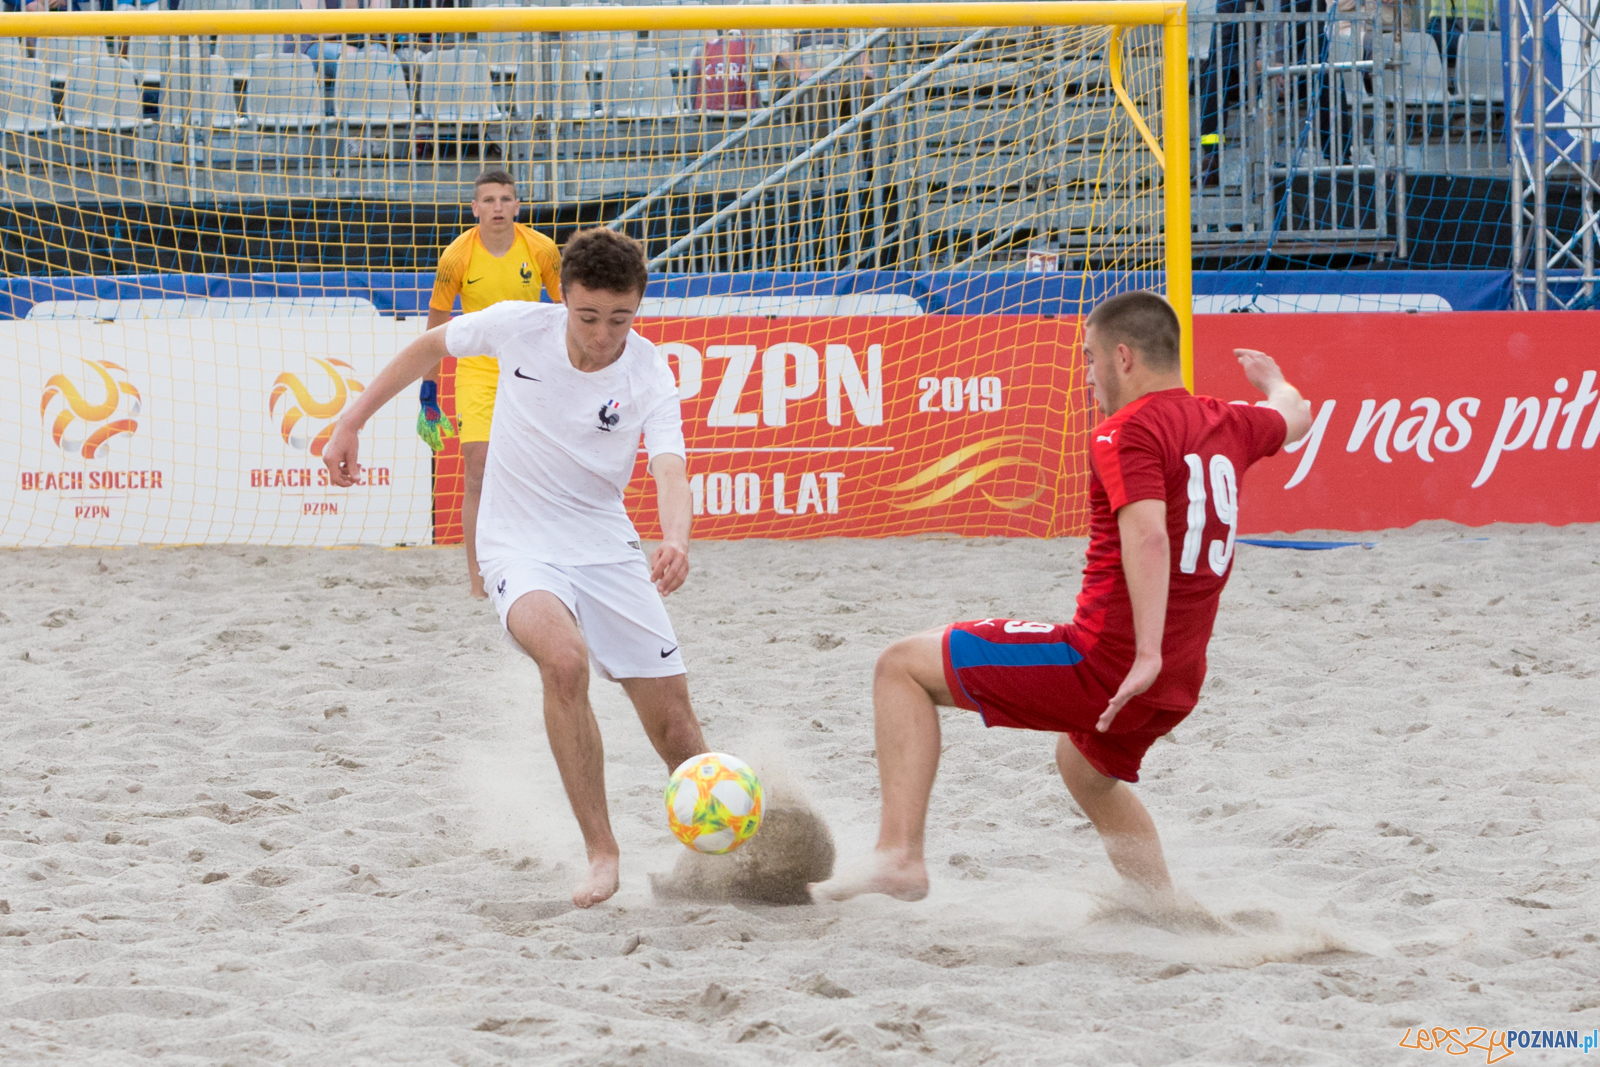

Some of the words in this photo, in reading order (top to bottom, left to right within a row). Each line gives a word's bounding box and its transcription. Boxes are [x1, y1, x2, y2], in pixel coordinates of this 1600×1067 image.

[657, 342, 883, 427] PZPN
[918, 376, 1002, 412] 2019
[1346, 397, 1480, 463] nas
[21, 471, 83, 490] BEACH
[88, 470, 162, 490] SOCCER
[250, 468, 311, 488] BEACH
[317, 467, 390, 487] SCER
[690, 472, 760, 515] 100
[773, 472, 845, 515] LAT
[75, 505, 110, 519] PZPN
[303, 502, 338, 516] PZPN
[1179, 453, 1239, 577] 19
